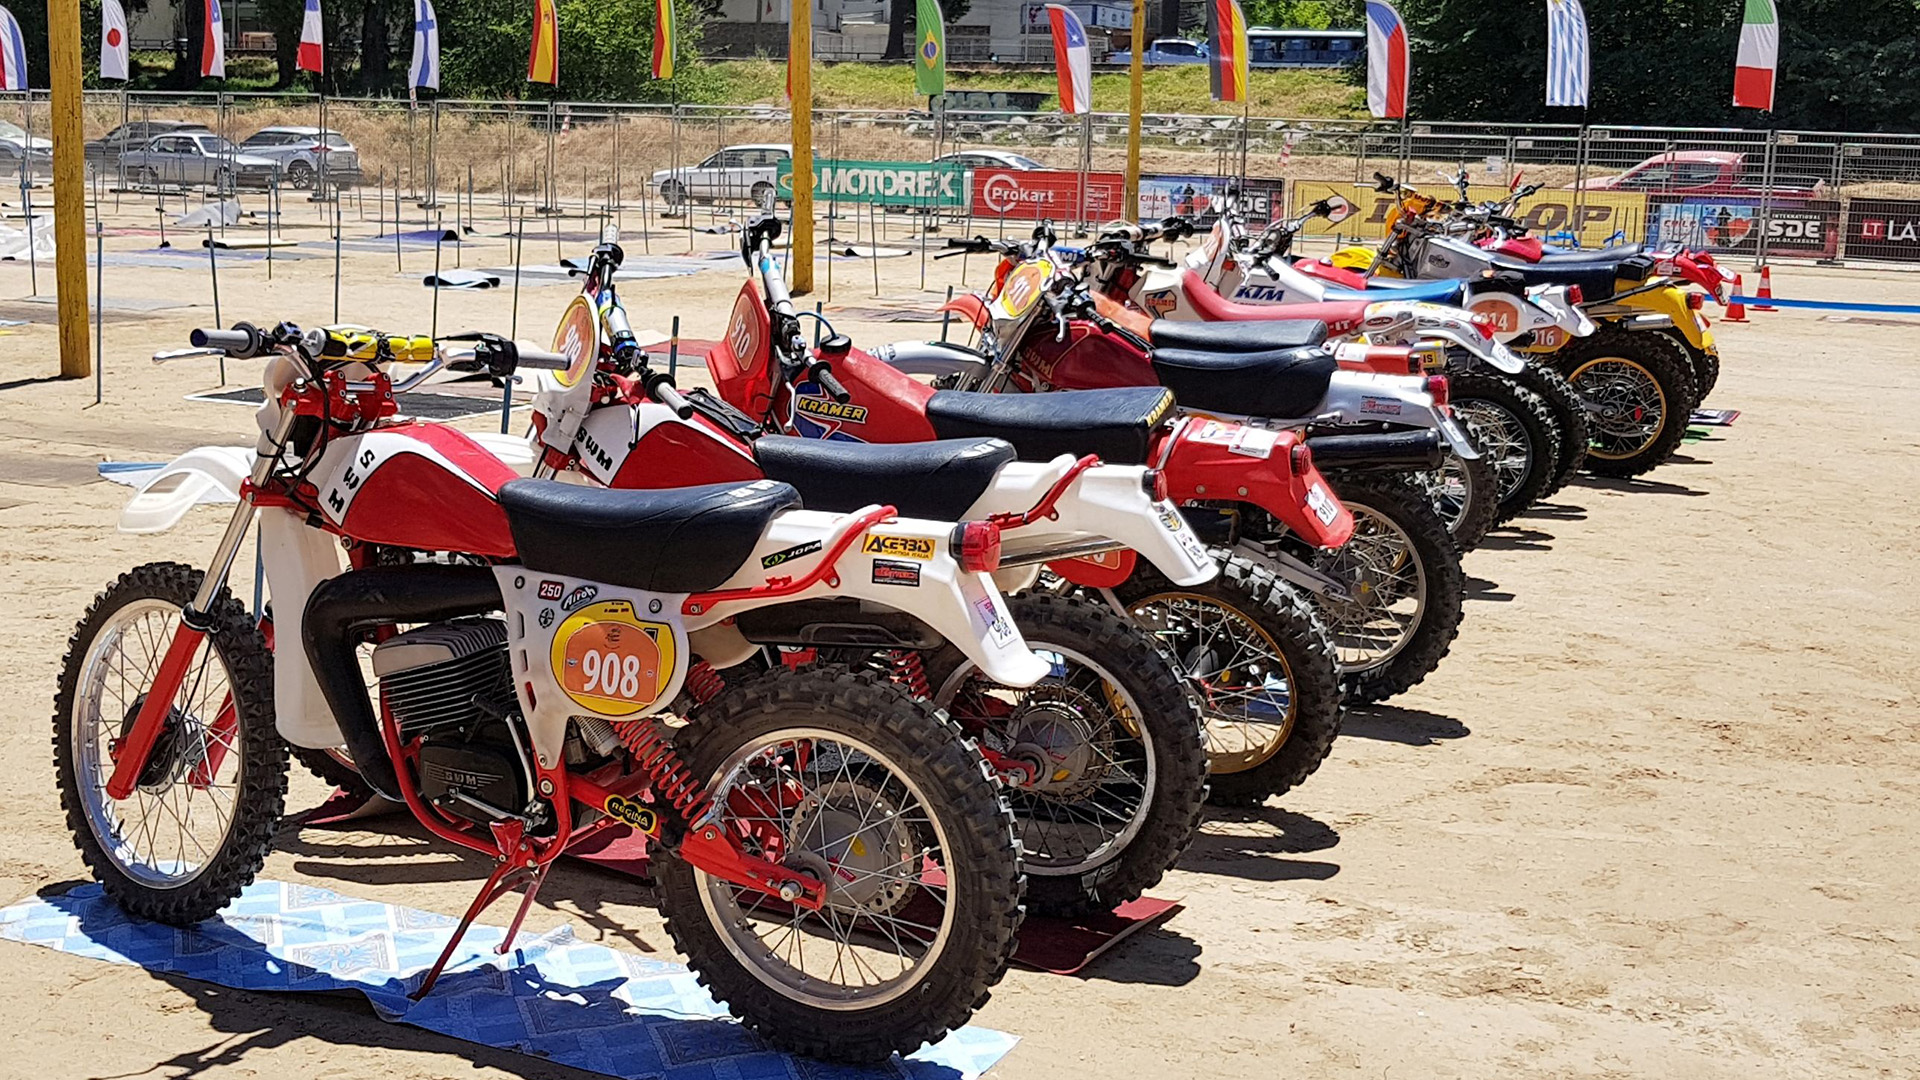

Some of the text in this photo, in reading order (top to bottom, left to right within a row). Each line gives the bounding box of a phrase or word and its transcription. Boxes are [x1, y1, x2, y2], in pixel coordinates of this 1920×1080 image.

[821, 167, 956, 198] MOTOREX
[991, 187, 1055, 203] Prokart
[1863, 222, 1882, 236] LT
[1887, 219, 1920, 242] LA
[1234, 284, 1286, 303] KTM
[731, 314, 751, 359] 910
[798, 397, 865, 420] KRAMER
[576, 426, 613, 472] SWM
[327, 449, 376, 514] SWM
[787, 541, 822, 559] JOPA
[540, 582, 563, 598] 250
[562, 585, 597, 610] Airoh
[582, 649, 641, 699] 908
[444, 772, 477, 786] SWM
[611, 801, 649, 827] REGINA
